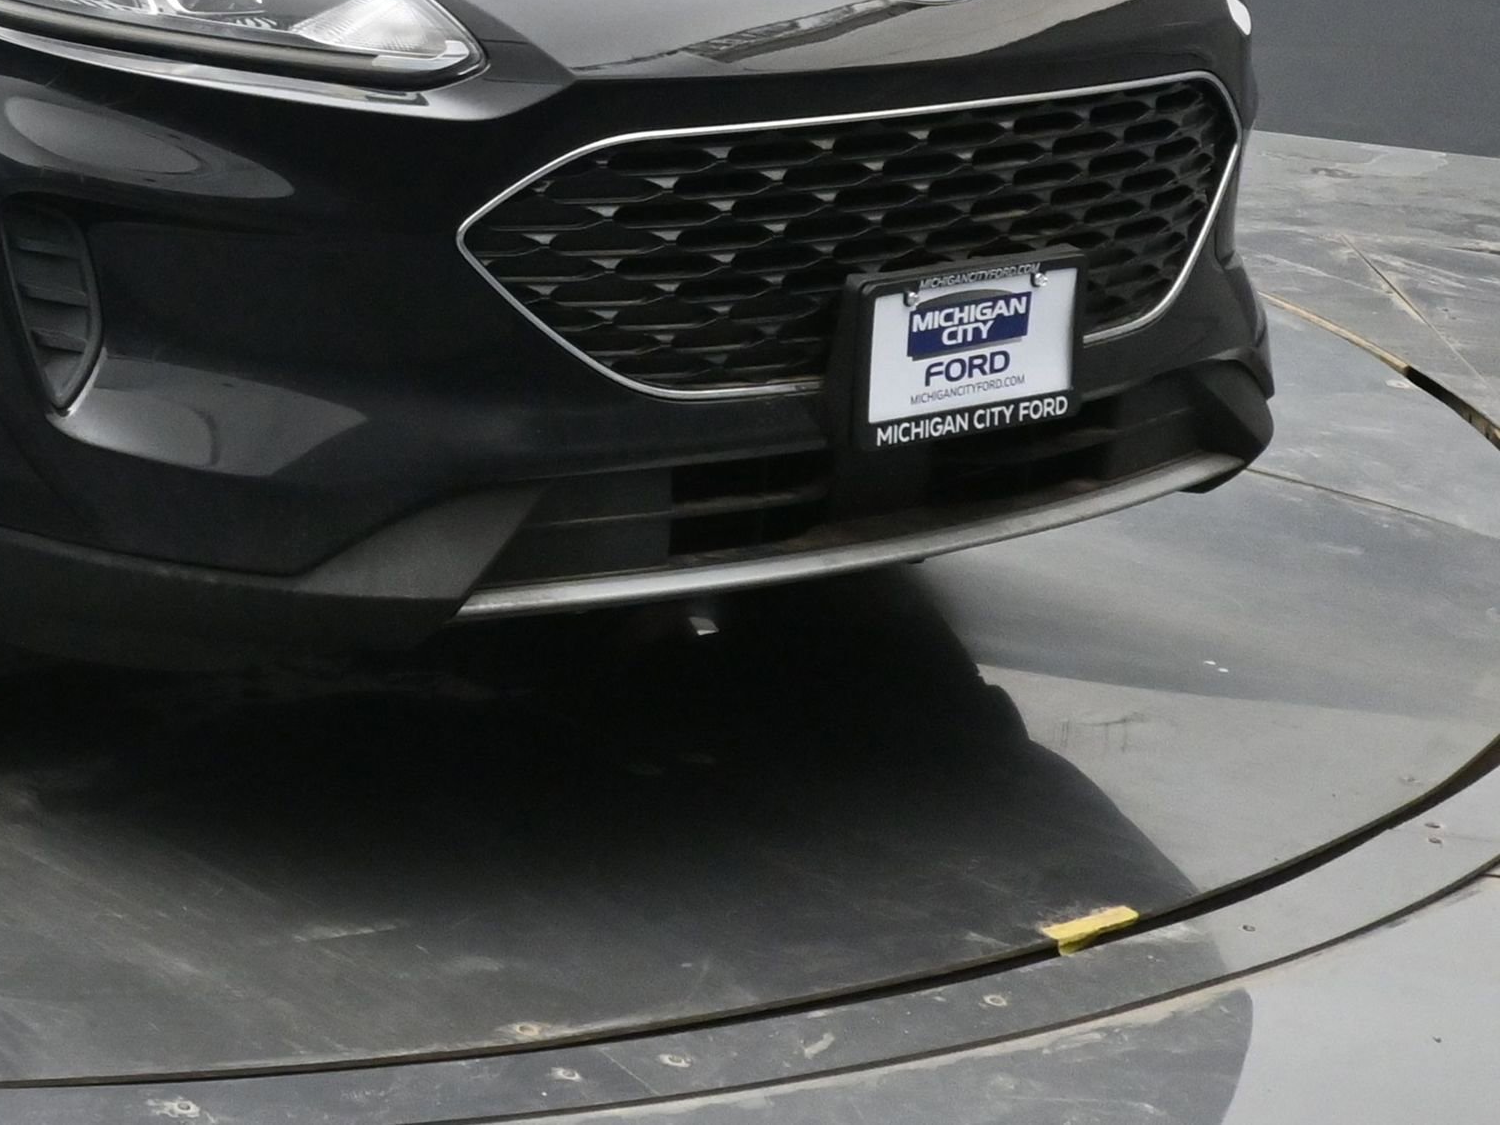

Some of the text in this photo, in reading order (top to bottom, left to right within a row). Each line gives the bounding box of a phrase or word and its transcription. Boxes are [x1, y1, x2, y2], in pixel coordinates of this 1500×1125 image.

[911, 296, 1027, 333] MICHIGAN
[940, 320, 995, 346] CITY
[924, 350, 1011, 387] FORD
[910, 374, 1026, 405] MICHIGANCITYFORD.COM
[876, 395, 1068, 447] MICHIGAN CITY FORD
